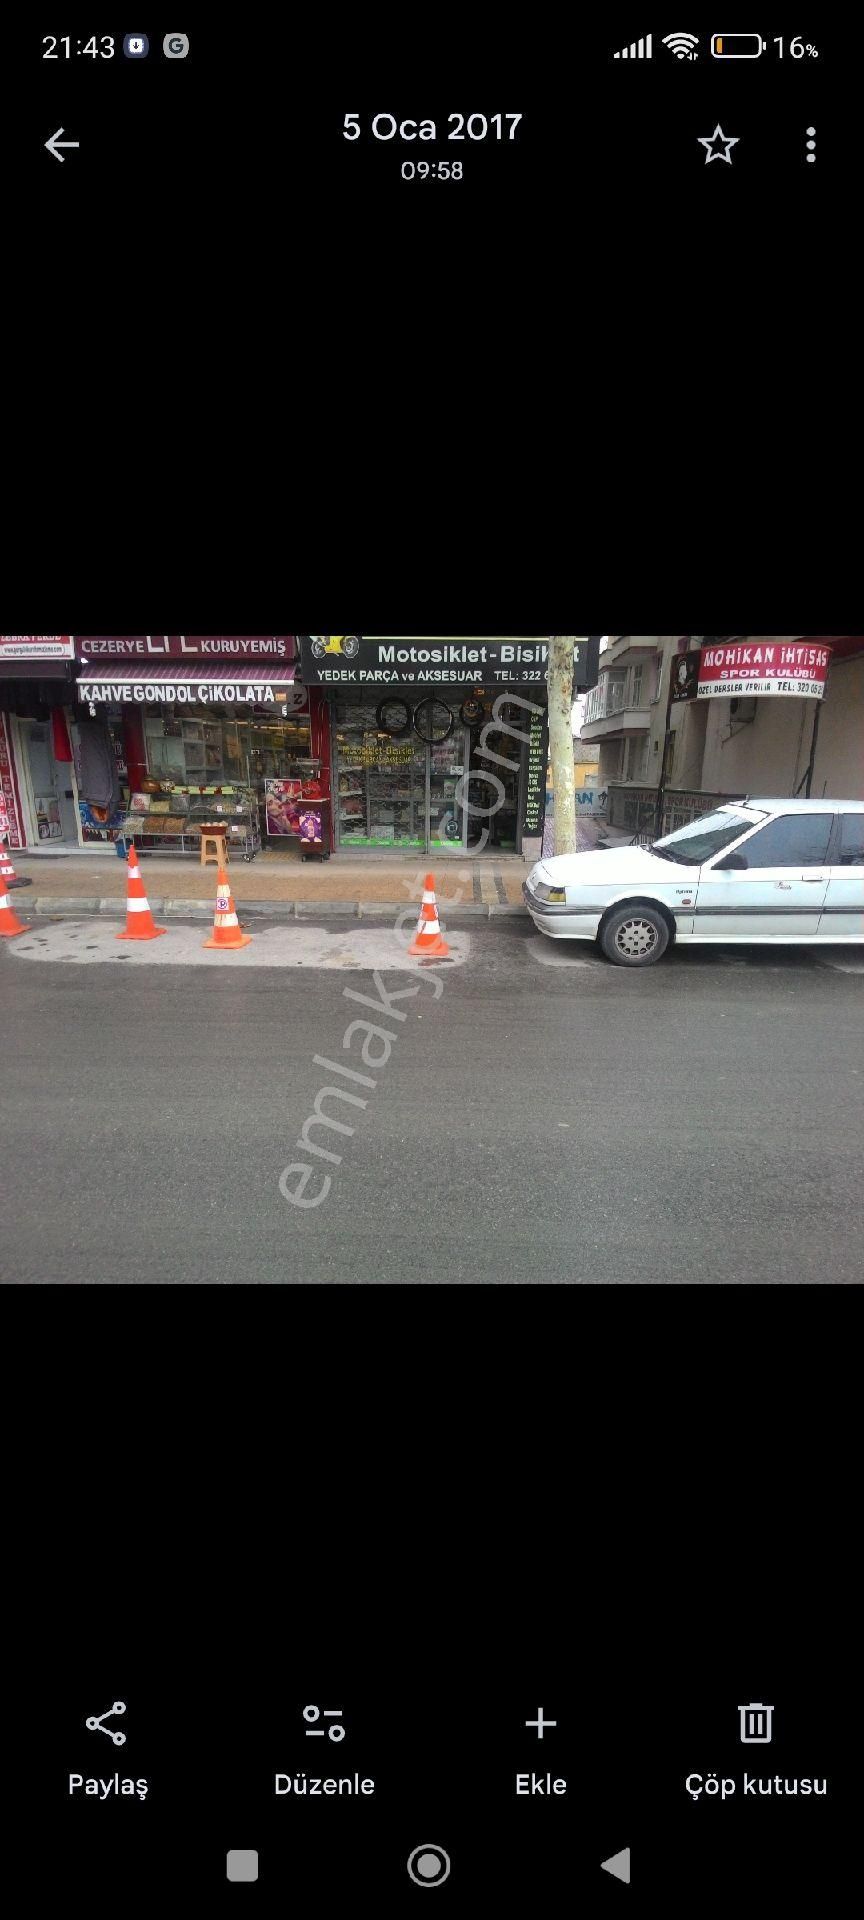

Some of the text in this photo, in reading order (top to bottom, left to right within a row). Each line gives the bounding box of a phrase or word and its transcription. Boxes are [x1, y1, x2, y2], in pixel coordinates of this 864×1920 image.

[43, 36, 114, 58] 21:43
[774, 36, 818, 58] 16%
[343, 114, 522, 140] 5 Oca 2017
[402, 162, 462, 180] 09:58
[81, 640, 145, 653] CEZERYE
[200, 637, 286, 656] KURUYEMİŞ
[317, 670, 357, 681] YEDEK
[359, 670, 399, 683] PARÇA
[401, 672, 415, 681] ve
[417, 670, 483, 681] AKSESUAR
[494, 670, 519, 681] TEL:
[522, 670, 541, 681] 322
[720, 667, 816, 679] SPOR KULÜBÜ
[79, 685, 132, 702] KAHVE
[133, 685, 196, 702] GONDOL
[778, 681, 795, 691] TEL:
[70, 1773, 148, 1800] Paylaş
[275, 1773, 375, 1795] Düzenle
[516, 1773, 567, 1795] Ekle
[686, 1773, 827, 1800] Çöp kutusu
